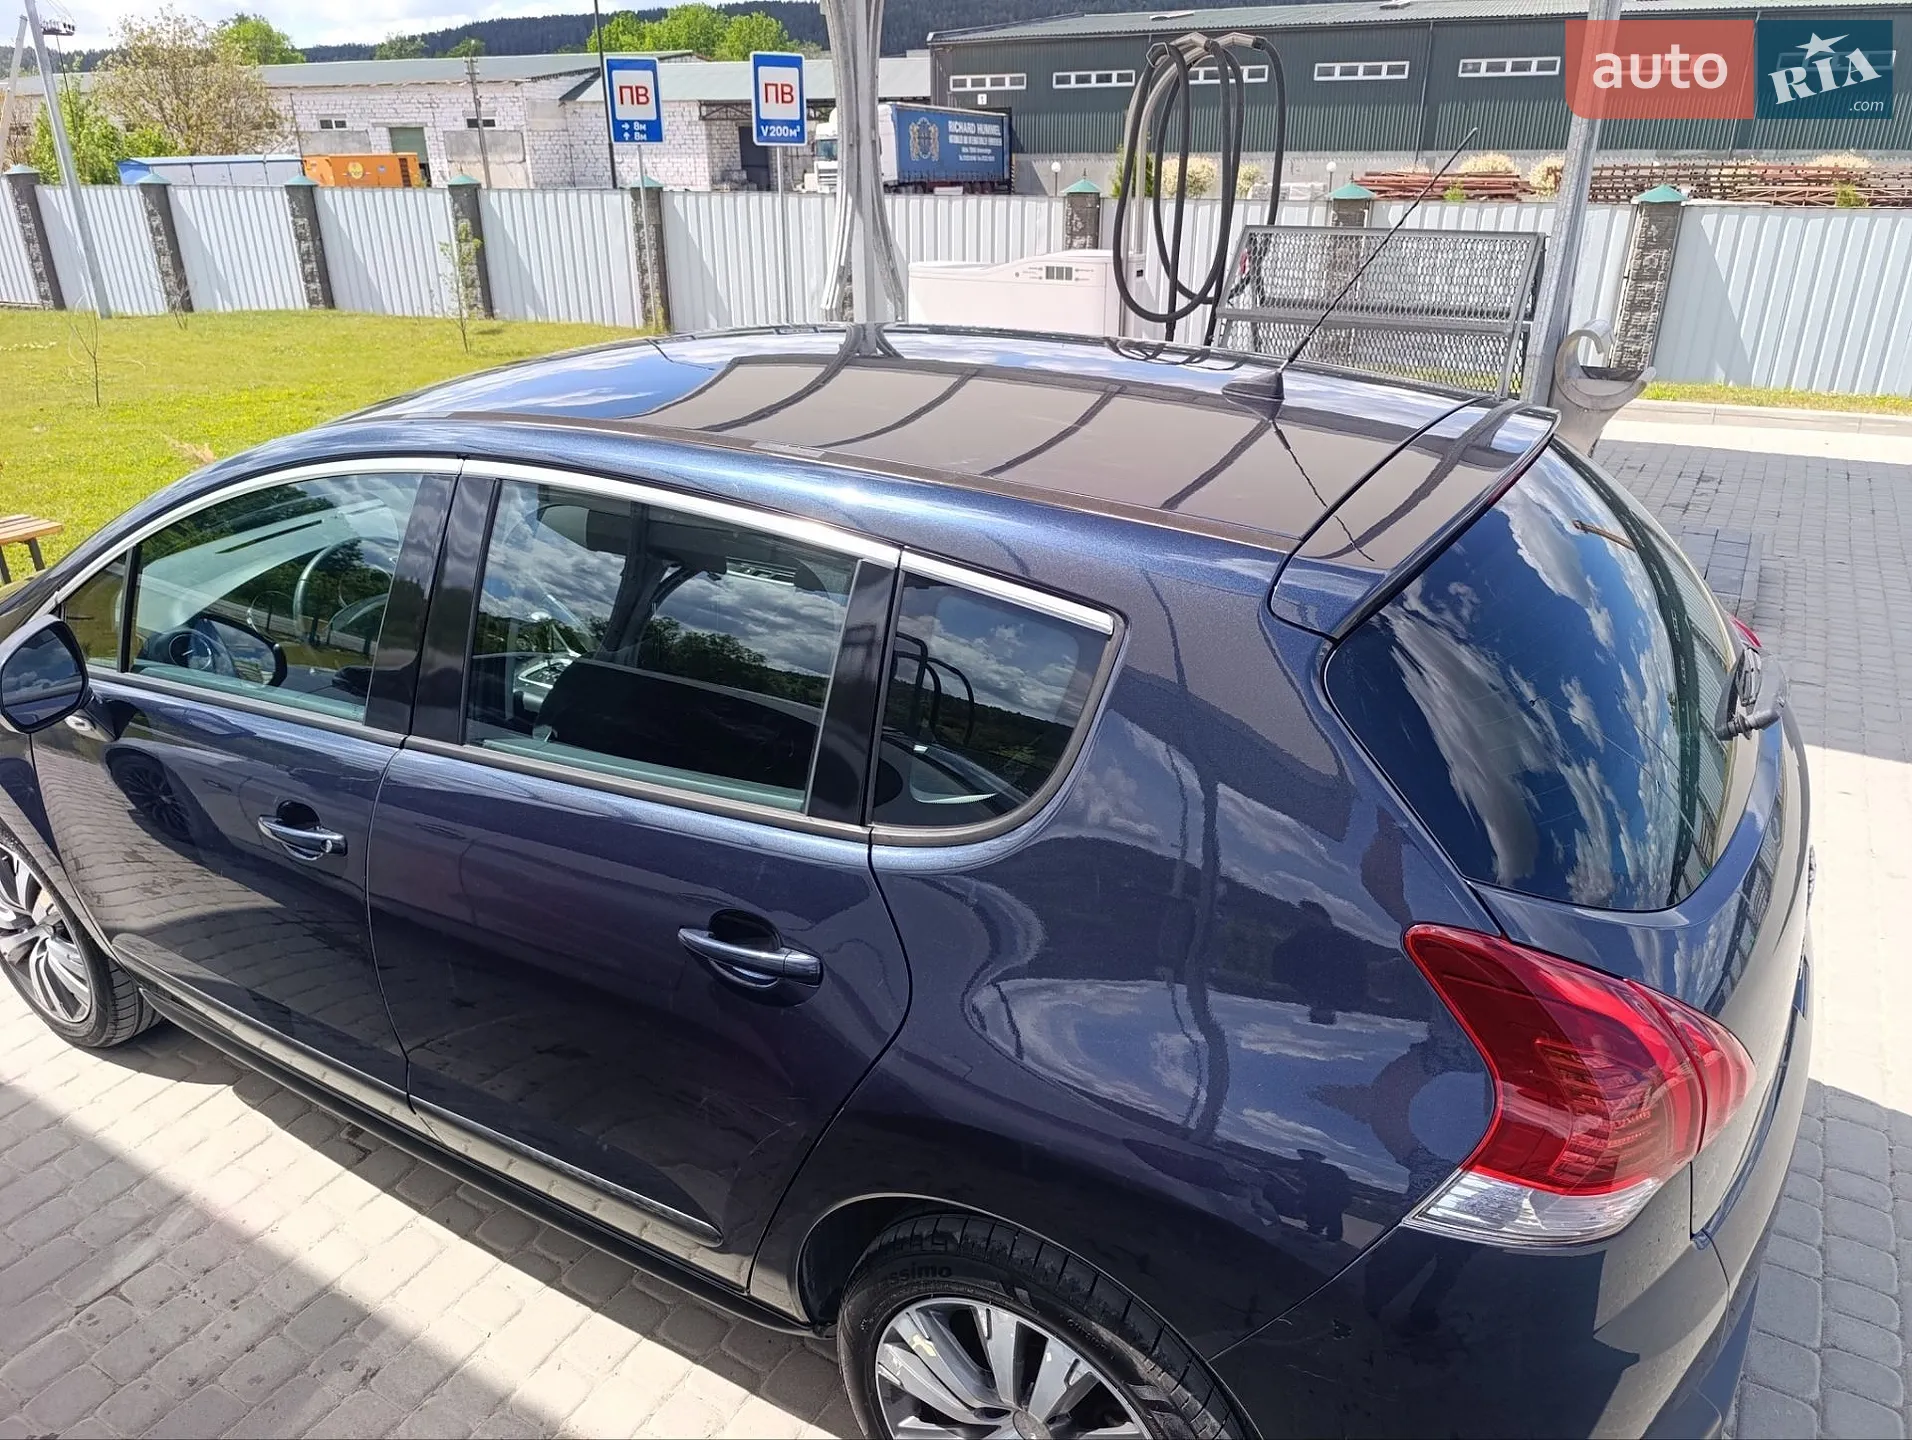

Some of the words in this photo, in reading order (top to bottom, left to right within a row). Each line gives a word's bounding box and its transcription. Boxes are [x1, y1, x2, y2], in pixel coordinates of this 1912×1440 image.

[619, 85, 650, 105] ПВ
[764, 82, 795, 104] ПВ
[948, 121, 976, 134] RICHARD
